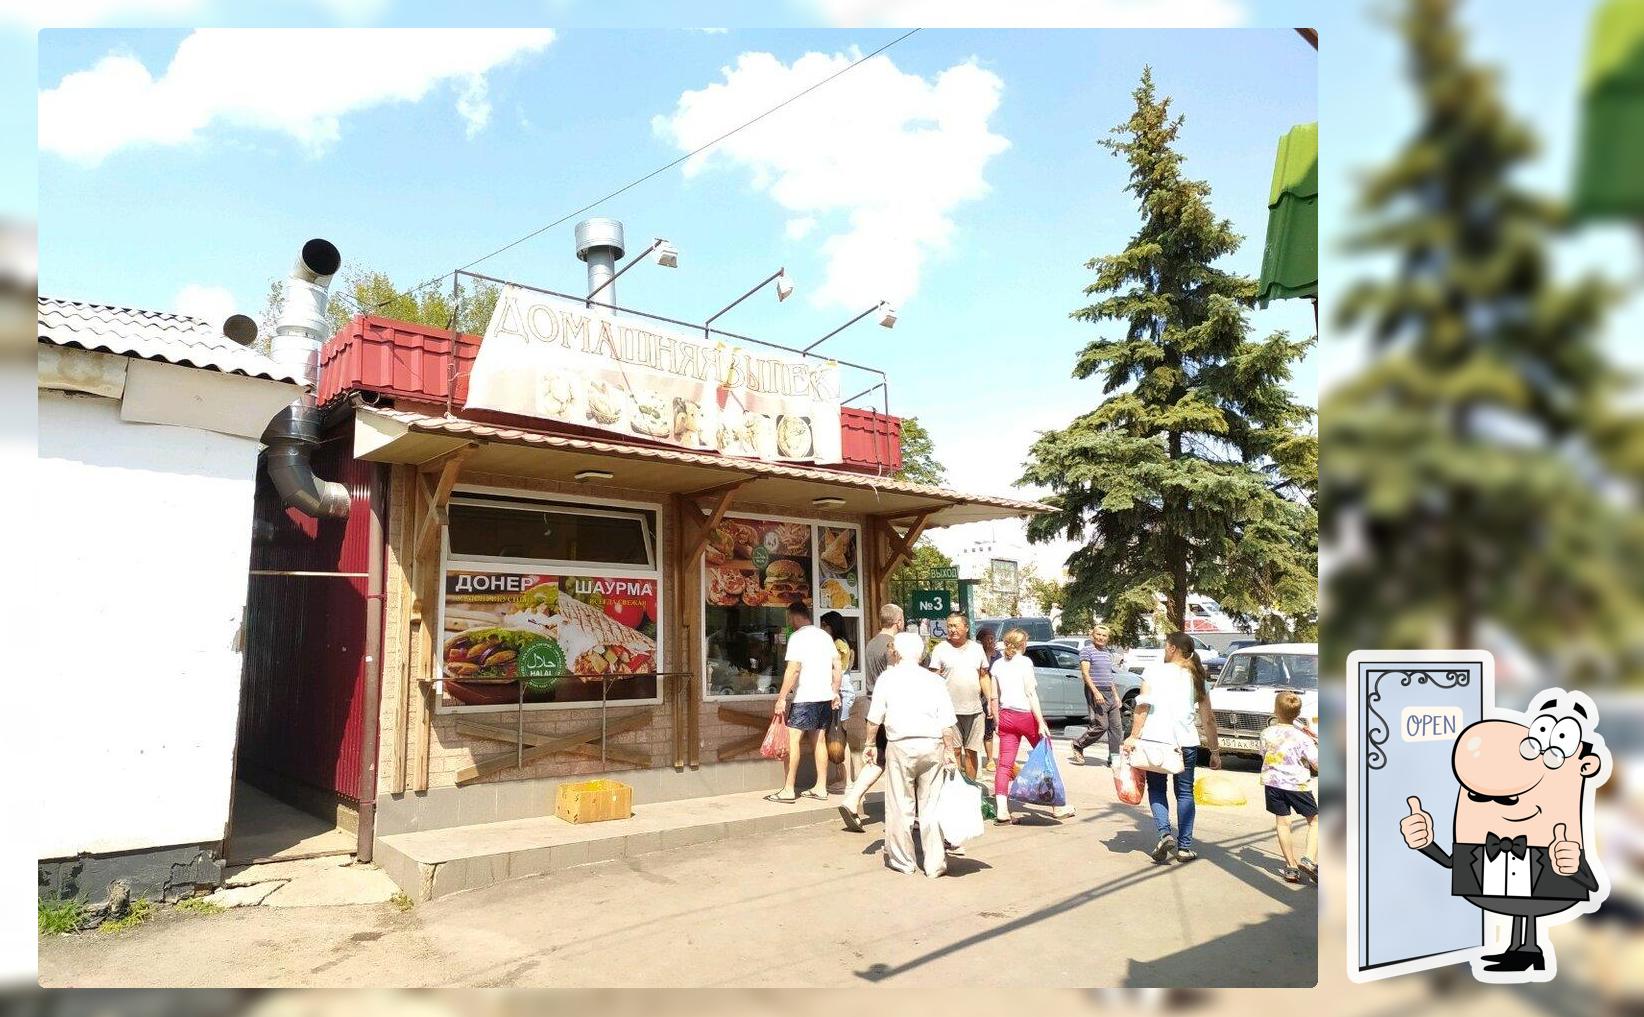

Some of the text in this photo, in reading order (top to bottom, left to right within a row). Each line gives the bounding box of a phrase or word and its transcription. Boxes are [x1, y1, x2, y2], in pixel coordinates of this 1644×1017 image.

[493, 296, 723, 382] ДОМАШНЯЯ
[931, 568, 957, 579] ВЫХОД
[455, 574, 534, 592] ДОНЕР
[575, 580, 653, 596] ШАУРМА
[527, 653, 556, 668] حلال
